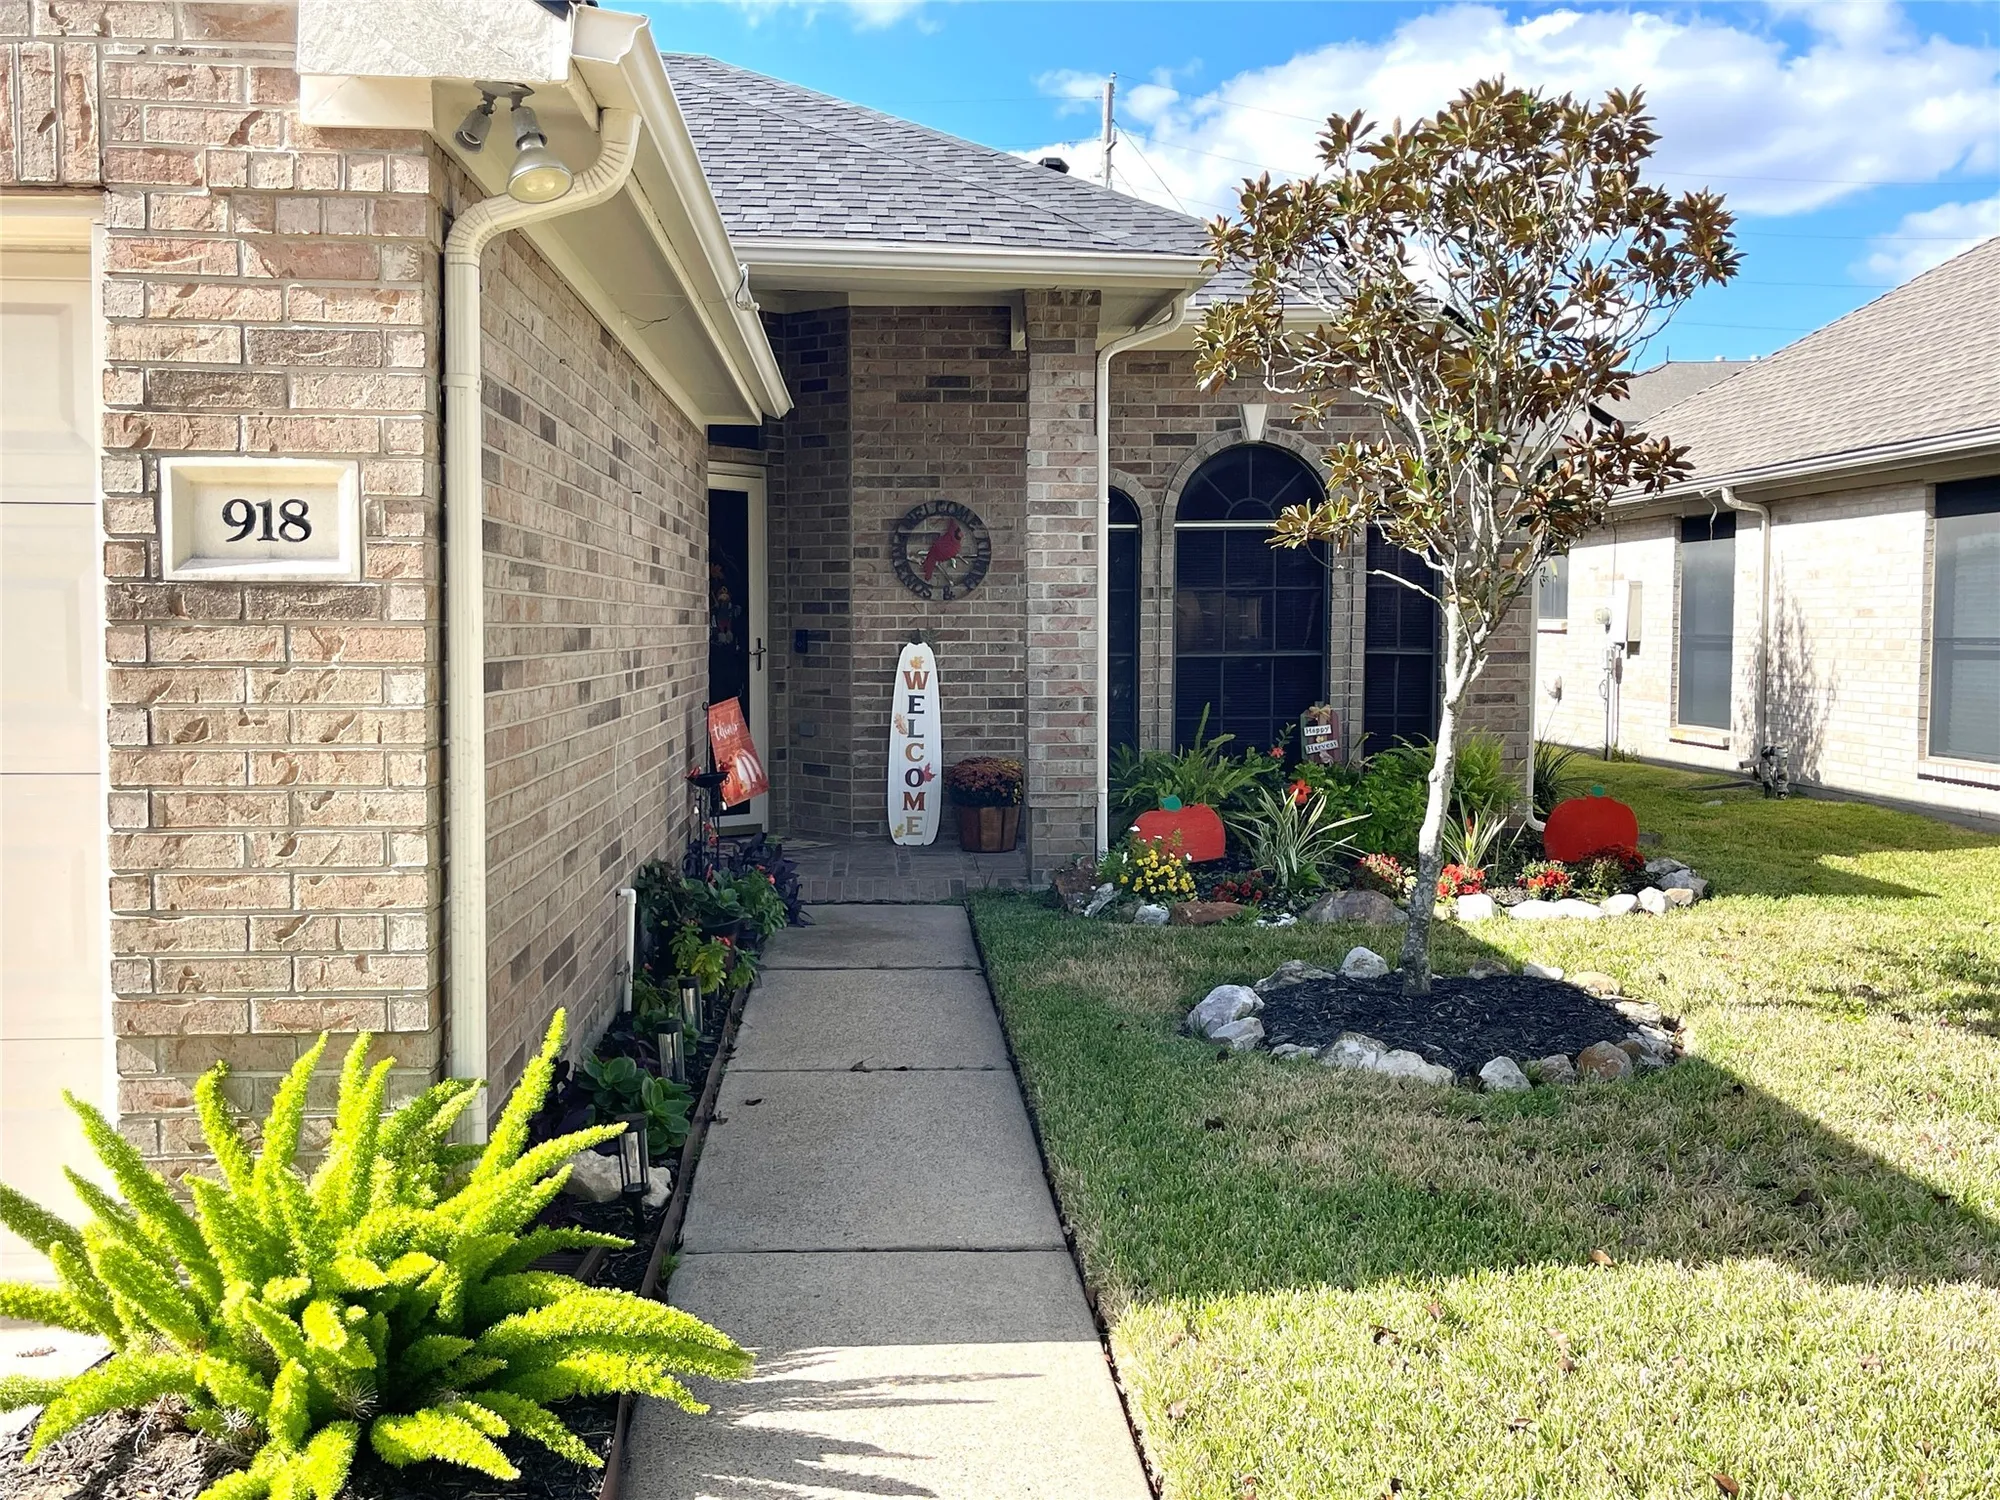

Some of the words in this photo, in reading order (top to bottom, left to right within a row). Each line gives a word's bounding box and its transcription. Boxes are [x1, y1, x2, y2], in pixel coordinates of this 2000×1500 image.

[221, 498, 312, 543] 918
[898, 500, 983, 532] WELCOME
[943, 585, 956, 600] &
[1305, 726, 1330, 735] Happy
[902, 670, 930, 836] WELCOME
[1307, 741, 1337, 752] Harvest
